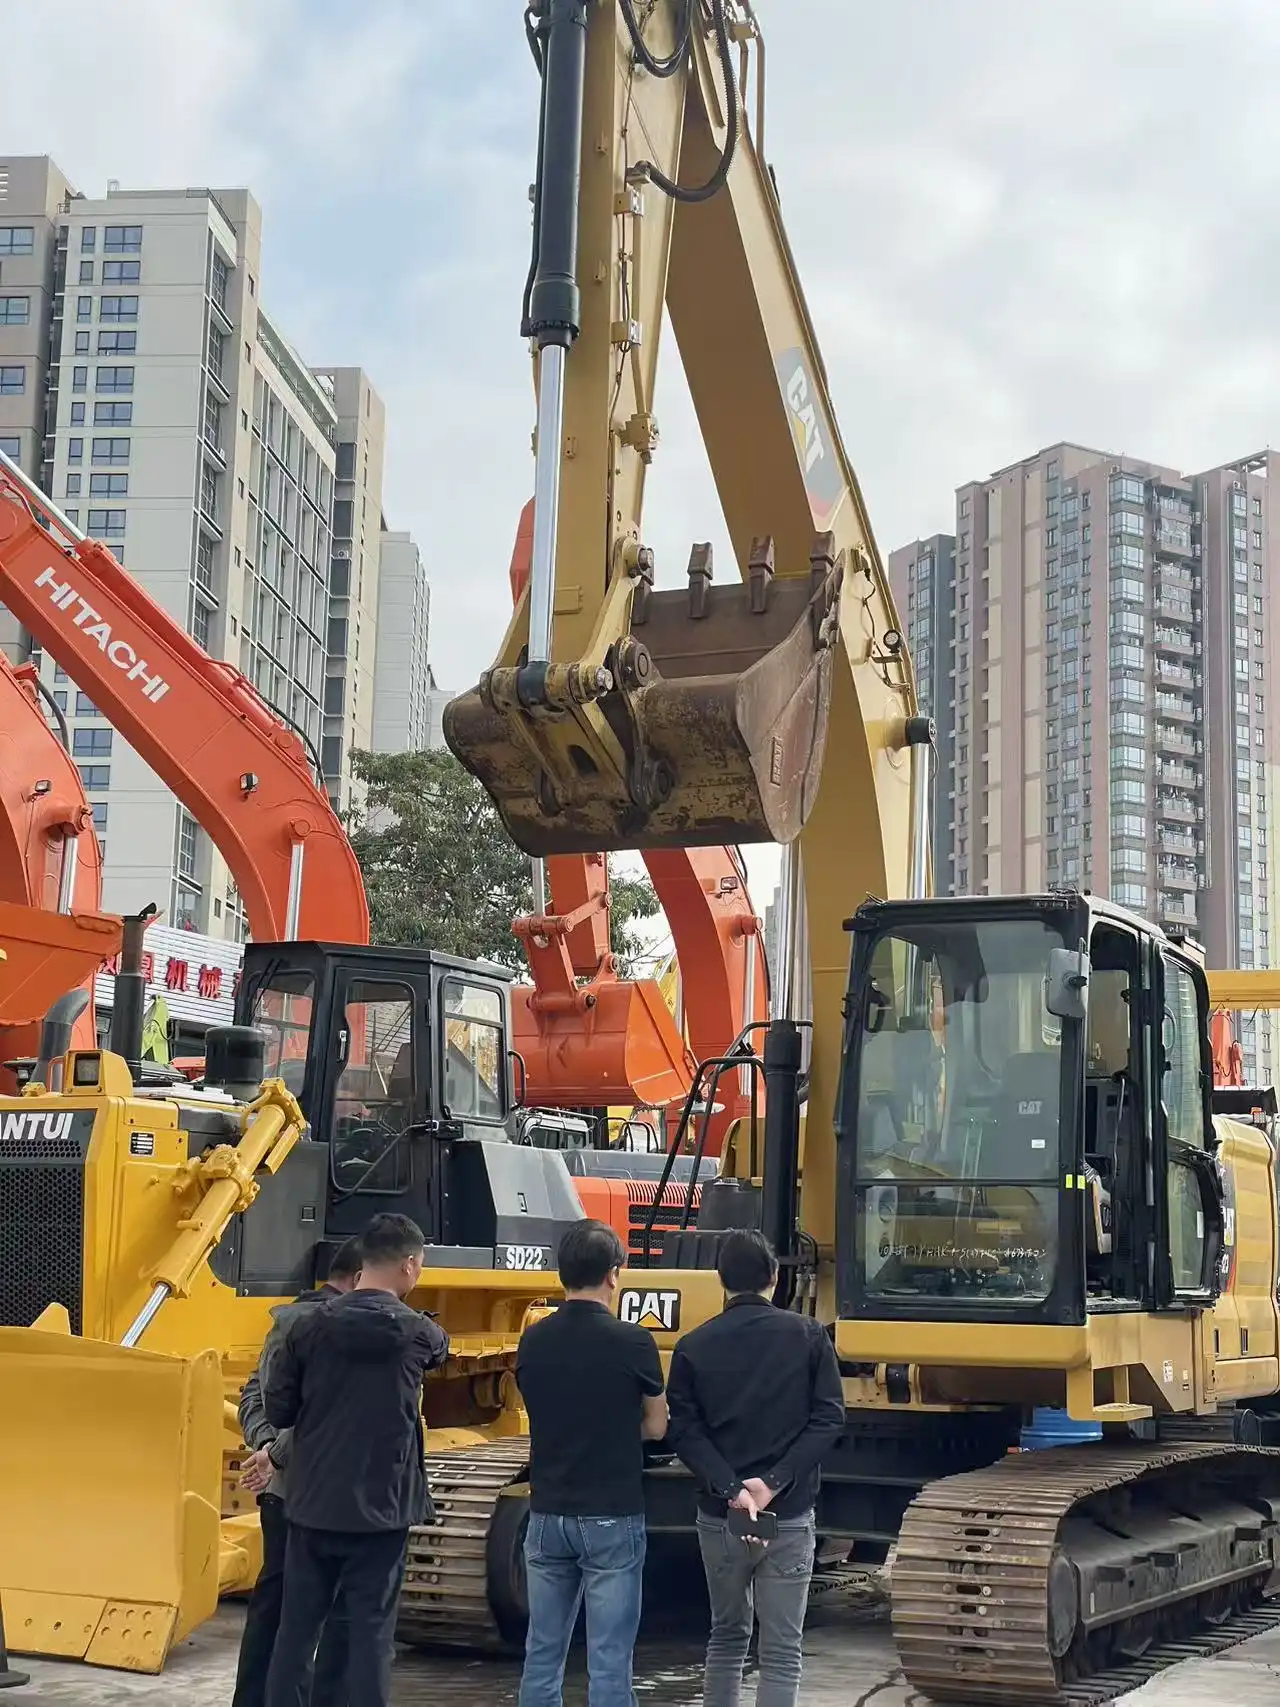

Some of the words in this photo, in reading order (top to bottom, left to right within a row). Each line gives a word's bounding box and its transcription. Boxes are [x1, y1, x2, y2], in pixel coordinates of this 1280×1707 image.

[787, 366, 824, 474] CAT
[34, 567, 170, 703] HITACHI
[1018, 1100, 1043, 1115] CAT
[0, 1112, 74, 1140] NTUI
[505, 1247, 543, 1271] SD22
[621, 1291, 678, 1329] CAT
